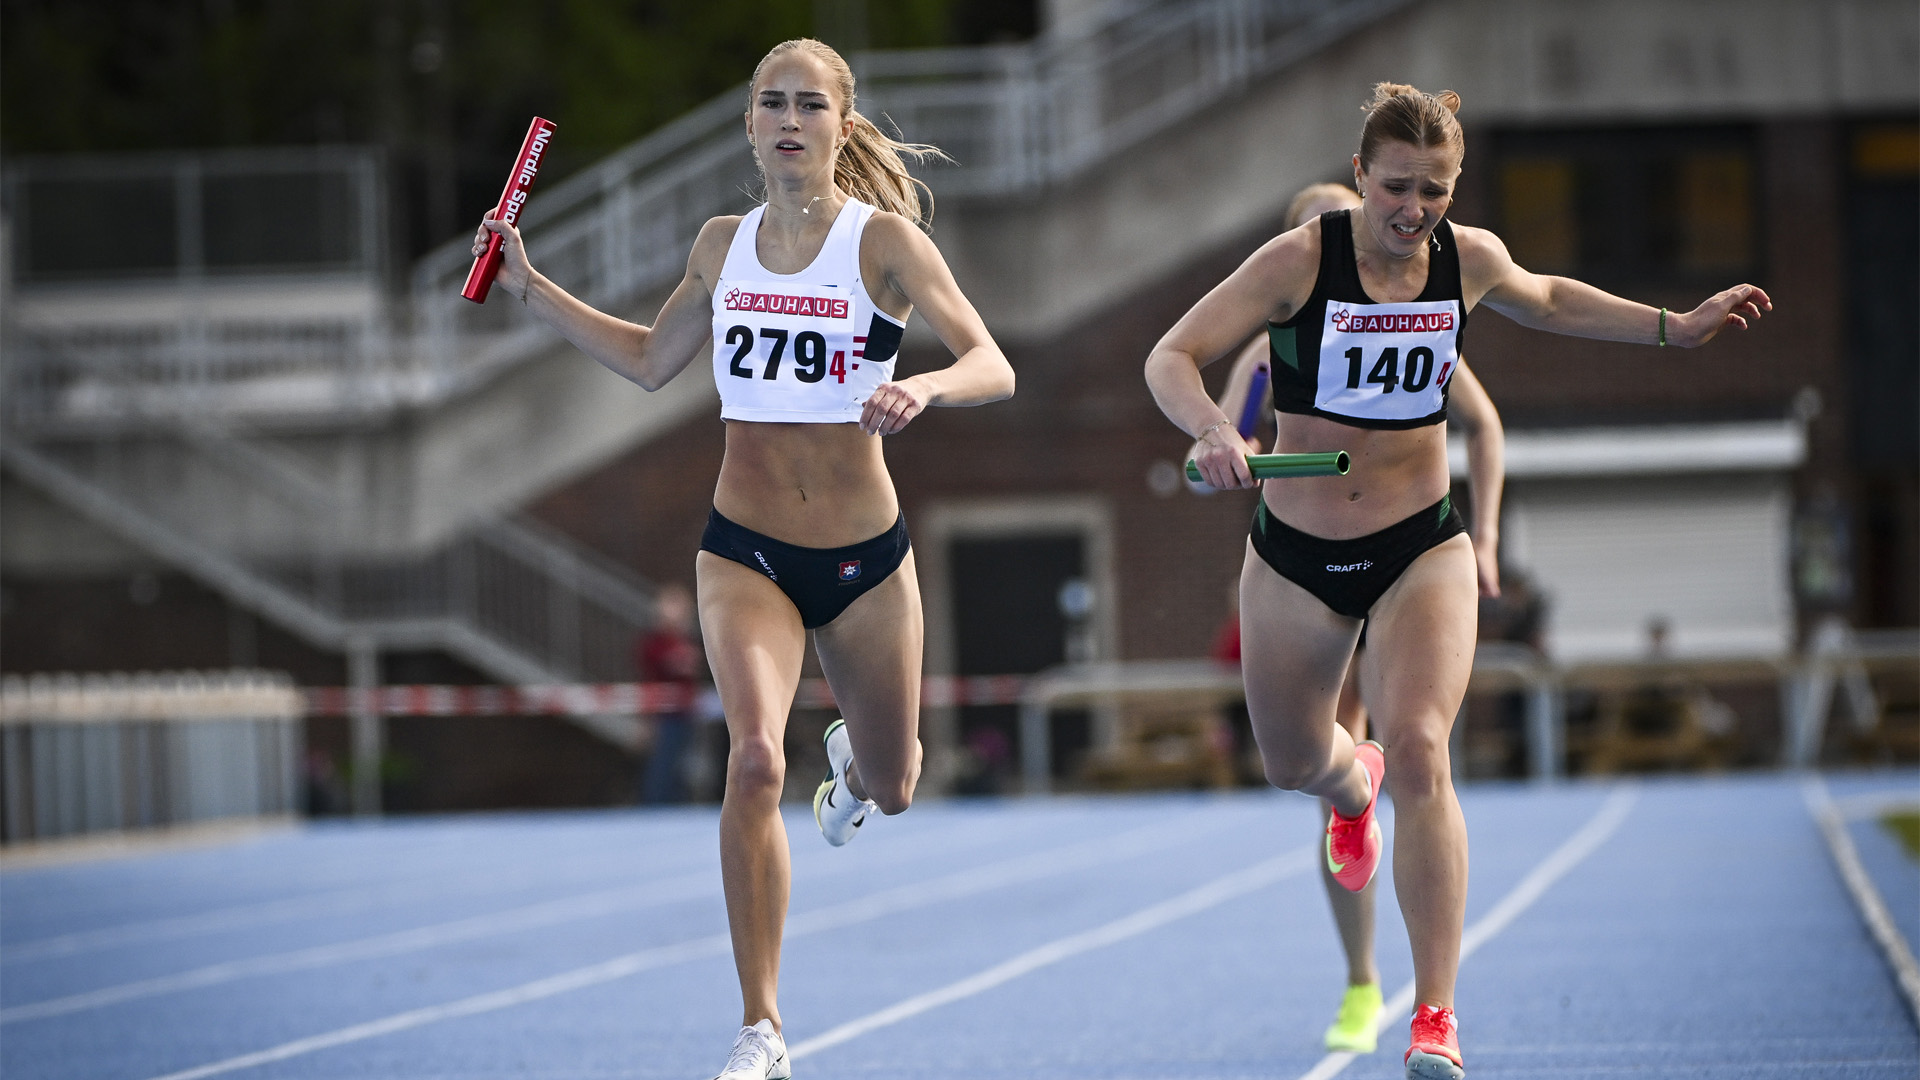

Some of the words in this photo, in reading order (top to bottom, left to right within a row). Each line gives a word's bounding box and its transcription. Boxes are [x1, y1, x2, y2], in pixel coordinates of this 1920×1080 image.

[518, 127, 552, 186] Nordic
[503, 189, 527, 226] Spo
[739, 293, 848, 318] BAUHAUS
[1351, 313, 1453, 332] BAUHAUS
[725, 325, 827, 384] 279
[829, 350, 847, 384] 4
[1344, 346, 1434, 394] 140
[754, 551, 774, 577] CRAFT
[1326, 562, 1363, 573] CRAFT
